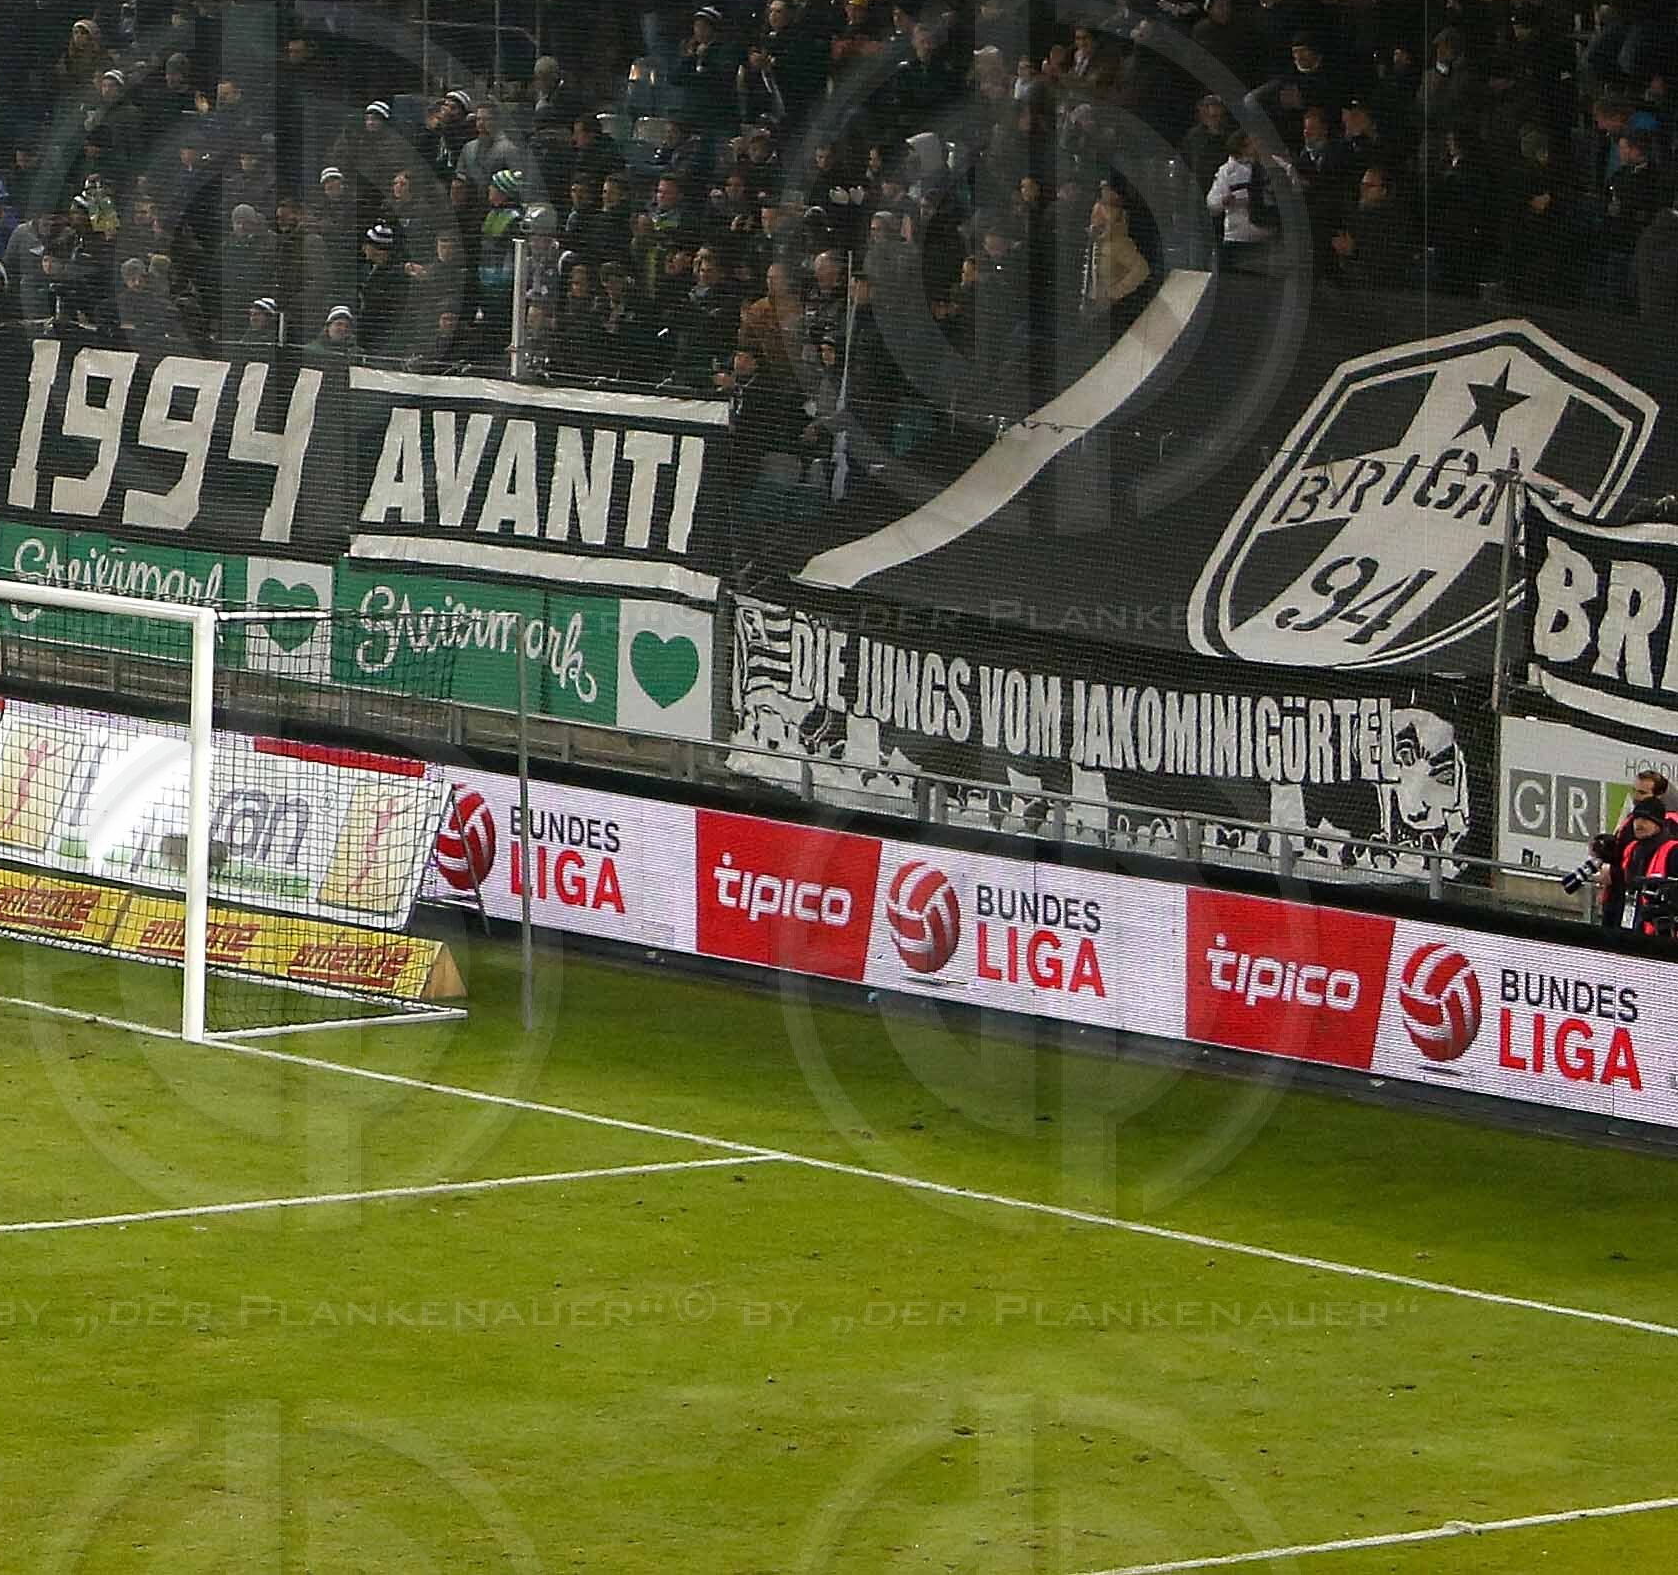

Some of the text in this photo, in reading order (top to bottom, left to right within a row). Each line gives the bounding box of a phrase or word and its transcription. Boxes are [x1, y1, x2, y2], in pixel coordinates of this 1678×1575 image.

[8, 338, 323, 543] 1994
[360, 407, 705, 555] AVANTI
[1275, 556, 1437, 644] 94
[356, 585, 598, 703] Steiermark
[790, 612, 848, 711] DIE
[854, 635, 970, 743] JUNGS
[978, 665, 1063, 759] VOM
[510, 803, 621, 853] BUNDES
[510, 840, 626, 915] LIGA
[713, 851, 852, 925] tipico
[976, 880, 1102, 934] BUNDES
[977, 919, 1106, 998] LIGA
[1206, 931, 1361, 1014] tipico
[1501, 968, 1640, 1023] BUNDES
[1500, 1007, 1644, 1091] LIGA
